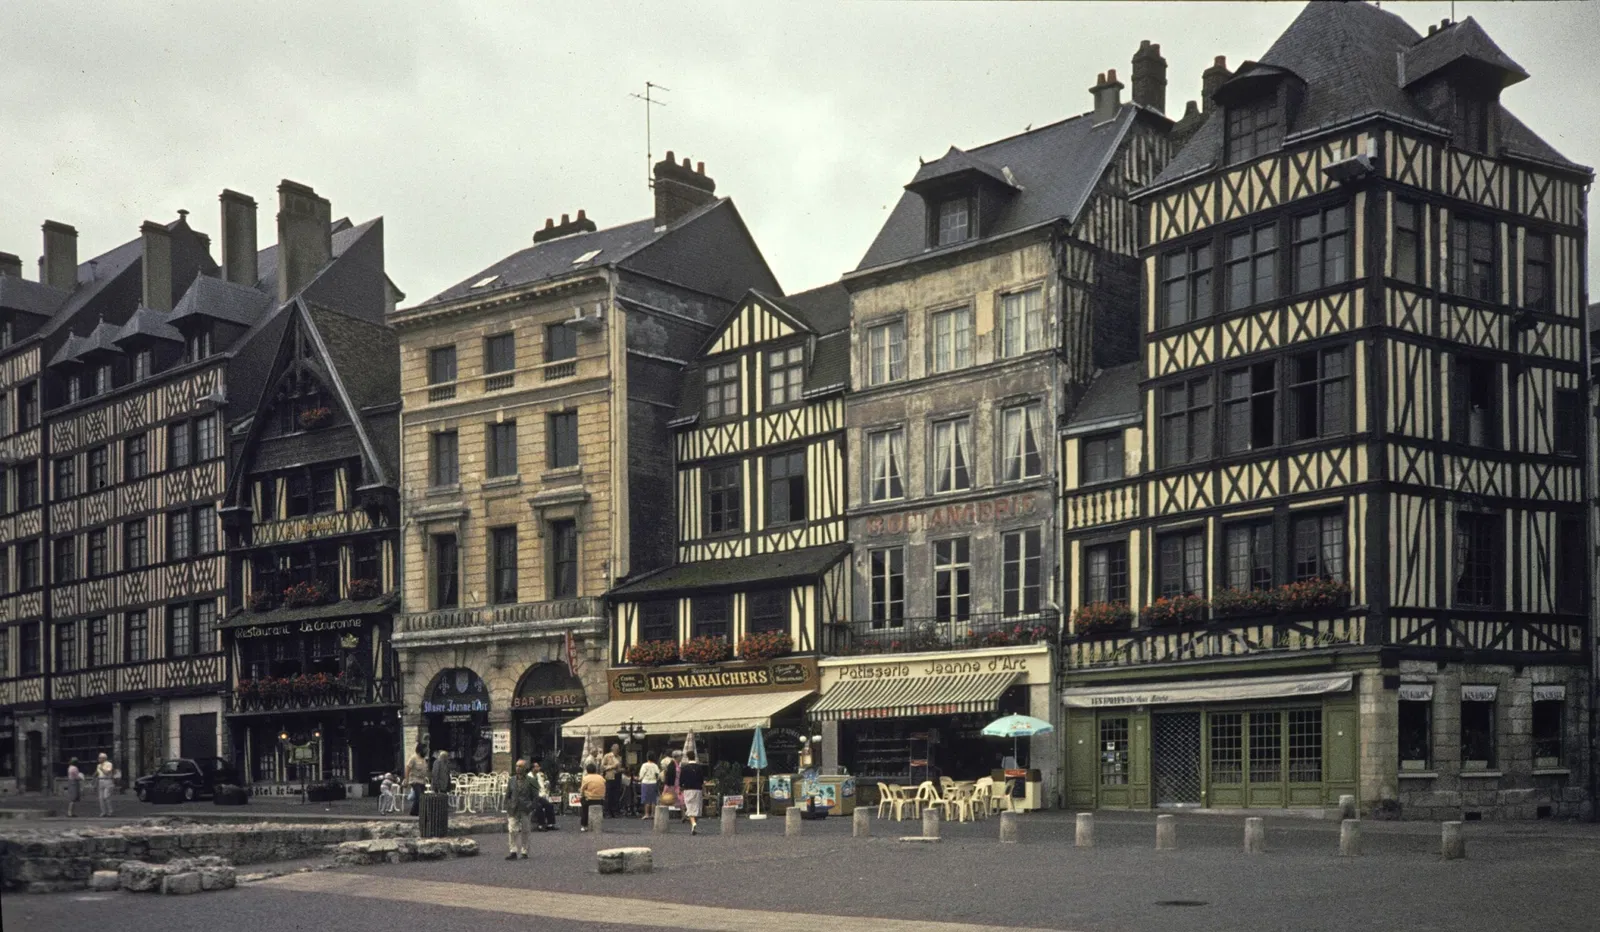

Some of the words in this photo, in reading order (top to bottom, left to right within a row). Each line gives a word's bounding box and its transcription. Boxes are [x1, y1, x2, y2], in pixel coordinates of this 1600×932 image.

[234, 625, 291, 639] Restaurant
[314, 618, 362, 631] Couronne
[925, 661, 981, 675] Jeanne
[987, 656, 1027, 671] d'Arc
[650, 676, 674, 690] LES
[678, 669, 768, 688] MARAICHERS
[446, 699, 471, 712] Jeanne
[514, 699, 535, 707] BAR
[540, 695, 576, 706] TABAC
